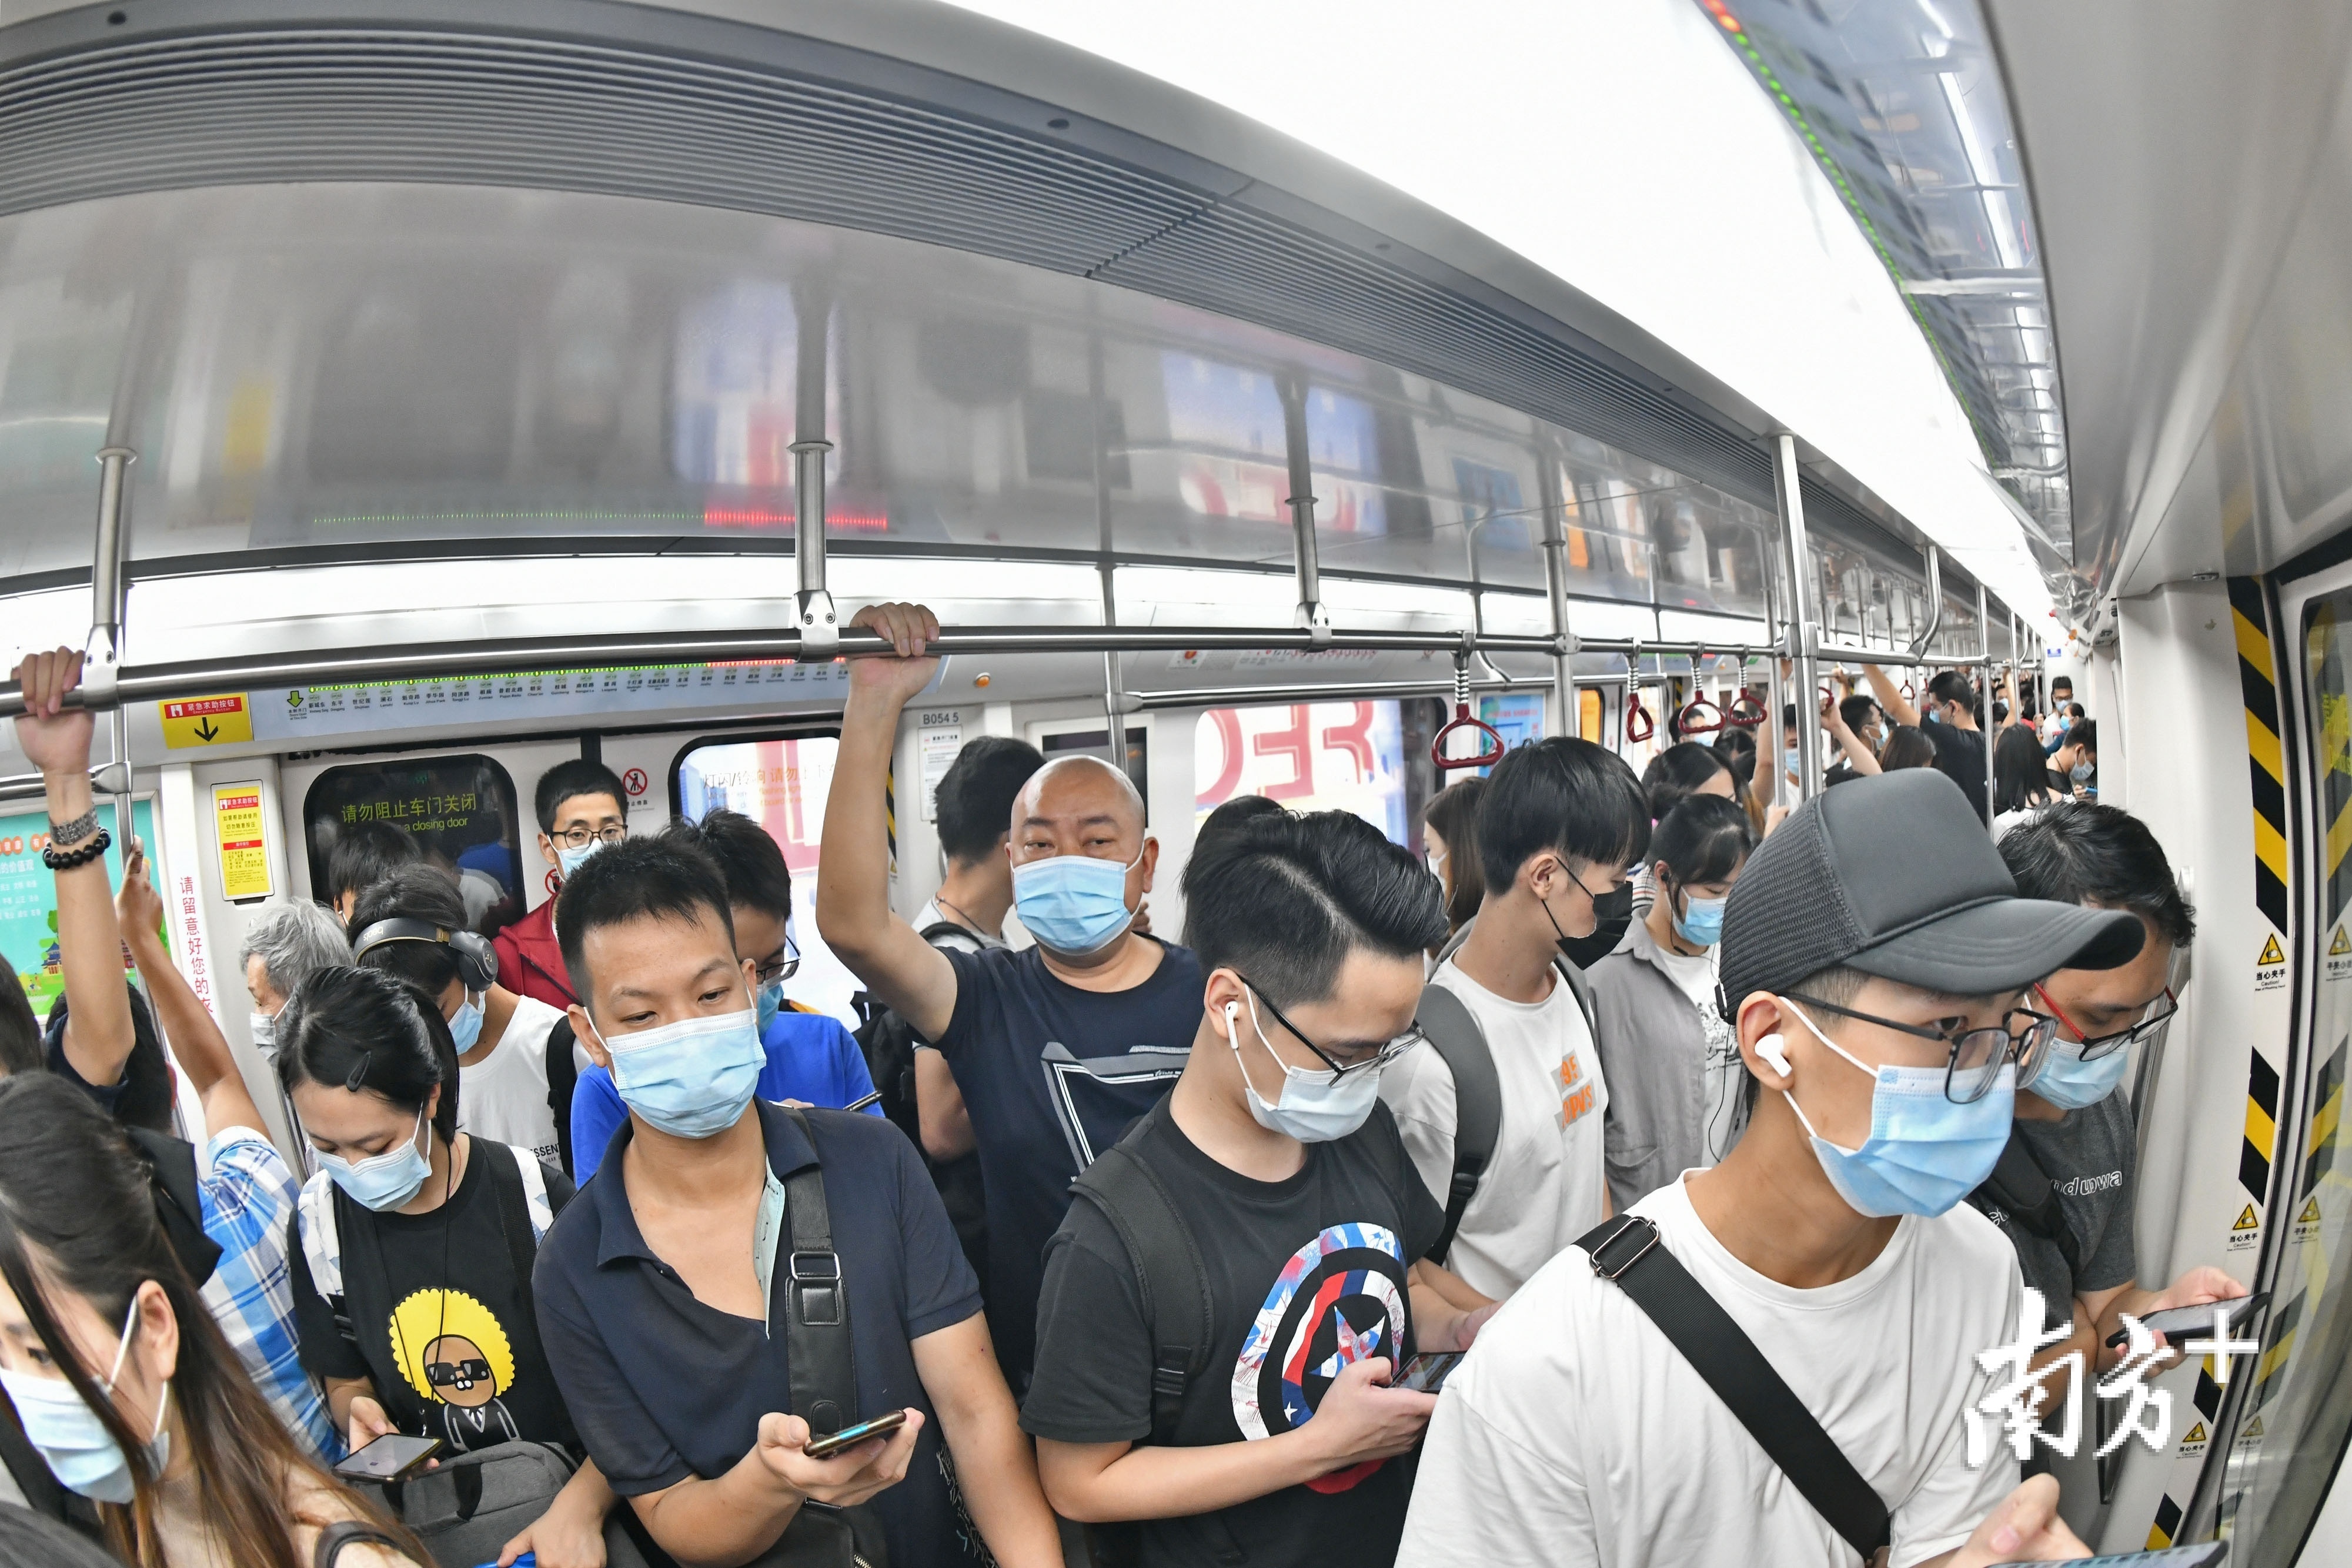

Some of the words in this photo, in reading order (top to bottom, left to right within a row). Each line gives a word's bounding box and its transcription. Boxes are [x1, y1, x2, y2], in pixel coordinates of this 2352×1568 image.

[188, 700, 235, 711] 紧急求助按钮
[923, 713, 950, 724] B054
[953, 712, 959, 723] 5
[227, 797, 258, 805] 紧急求助按钮
[342, 793, 476, 824] 请勿阻止车门关闭
[413, 819, 445, 831] closing
[447, 817, 469, 828] door
[363, 927, 383, 941] beats
[2256, 969, 2286, 981] 当心夹手
[530, 1143, 559, 1158] SSEN
[2230, 1233, 2258, 1243] 当心夹手
